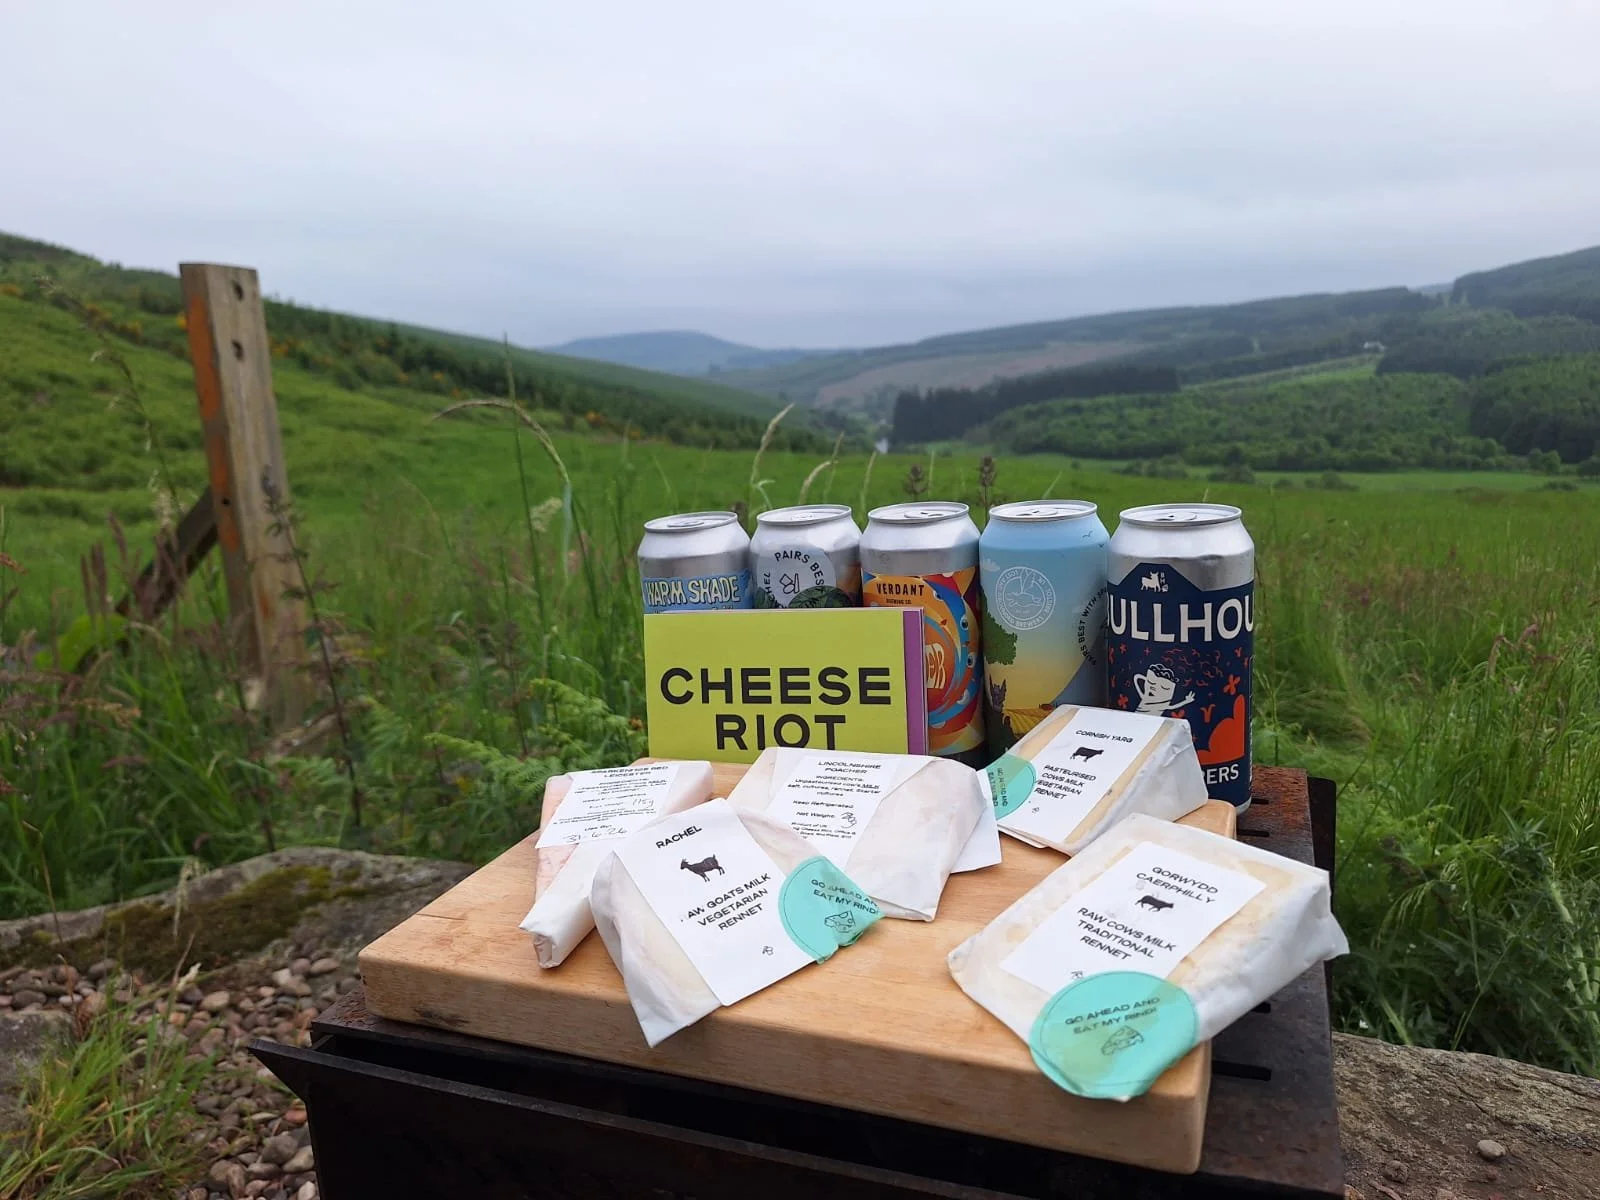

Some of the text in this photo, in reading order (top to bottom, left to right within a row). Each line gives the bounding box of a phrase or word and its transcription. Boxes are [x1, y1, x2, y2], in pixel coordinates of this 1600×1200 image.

[774, 550, 810, 564] PAIRS
[645, 576, 741, 606] WARM SHADE
[876, 583, 924, 596] VERDANT
[1078, 620, 1086, 643] BEST
[1082, 596, 1097, 618] WITH
[1107, 594, 1254, 643] ULLHOU
[925, 643, 946, 689] ER
[660, 667, 892, 705] CHEESE
[715, 713, 847, 750] RIOT
[1075, 730, 1133, 743] CORNISH YARG
[818, 761, 881, 769] LINCOLNSHIRE
[1043, 765, 1097, 781] PASTEURISED
[1202, 763, 1239, 785] ERS
[1034, 787, 1067, 800] RENNET
[1035, 779, 1082, 796] EGETARIAN
[1041, 773, 1085, 788] COWS MILK
[656, 825, 702, 849] RACHEL
[706, 886, 744, 909] GOATS
[743, 873, 771, 891] MILK
[811, 879, 826, 889] GO
[864, 897, 878, 908] AN
[1136, 872, 1216, 904] CAERPHILLY
[1152, 866, 1218, 894] GORWYDD
[697, 888, 768, 927] VEGETARIAN
[813, 889, 834, 902] EAT
[835, 896, 851, 906] MY
[718, 903, 763, 930] RENNET
[1077, 907, 1177, 952] RAW COWS MILK
[1077, 920, 1155, 958] TRADITIONAL
[1080, 935, 1132, 960] RENNET
[1065, 996, 1160, 1025] GO AHEAD AND
[1073, 1023, 1099, 1034] EAT
[1101, 1016, 1121, 1027] MY
